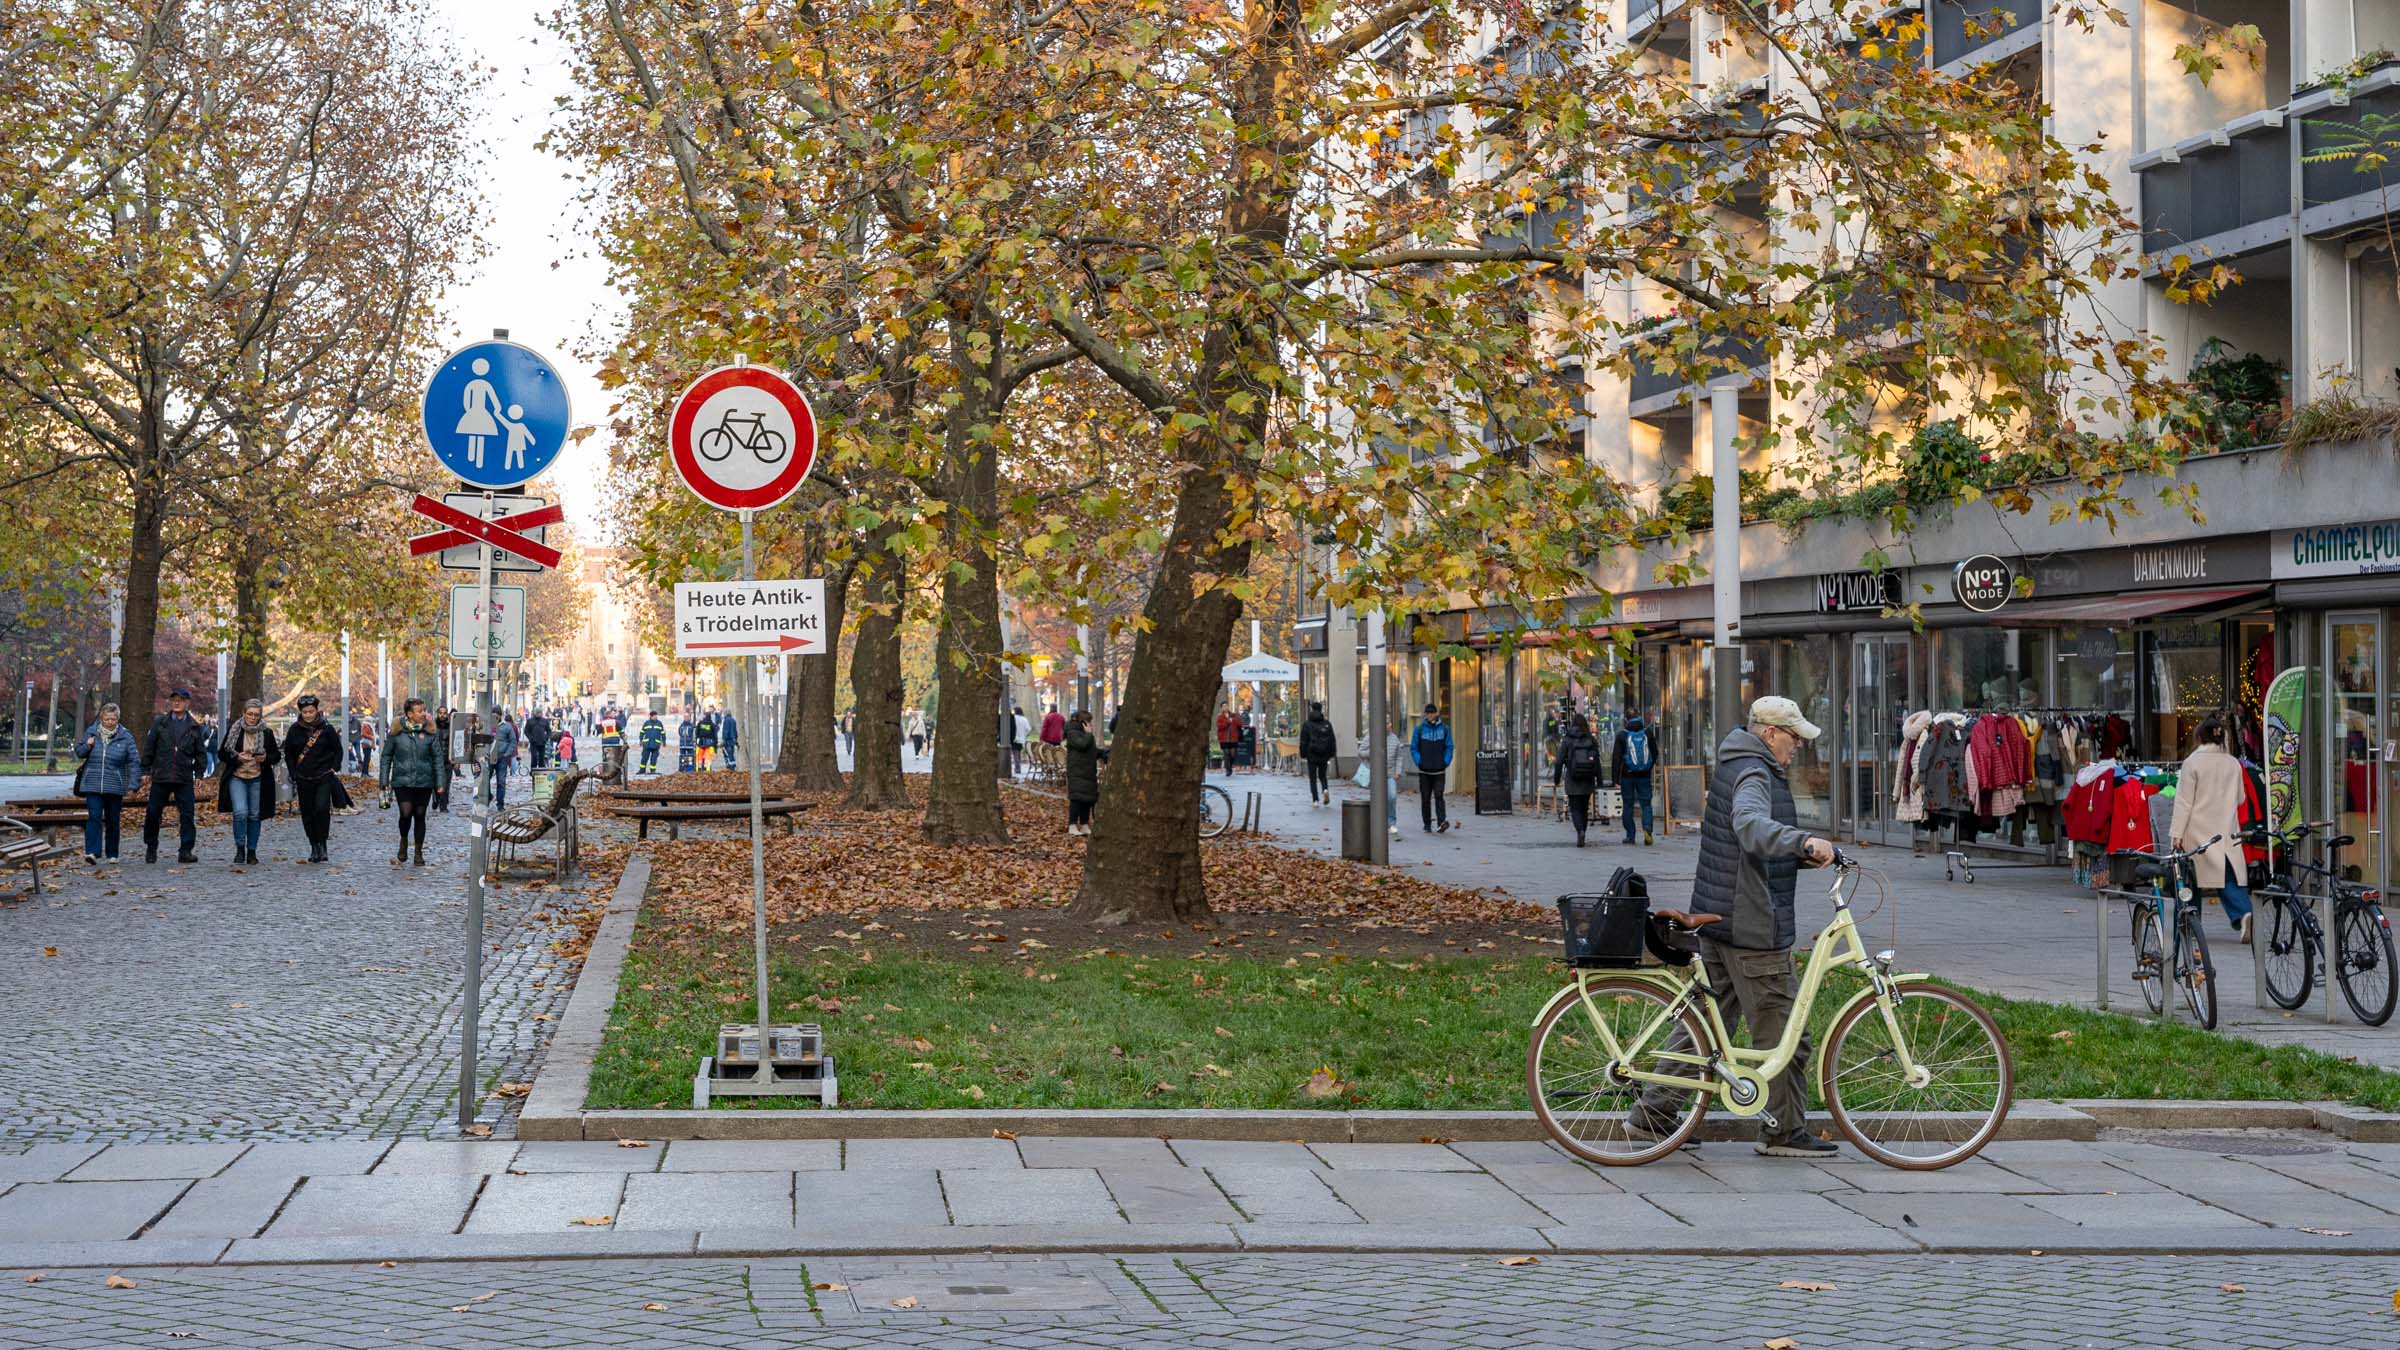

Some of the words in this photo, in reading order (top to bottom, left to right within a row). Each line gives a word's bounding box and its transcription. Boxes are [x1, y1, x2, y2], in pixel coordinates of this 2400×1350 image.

[2133, 545, 2207, 582] DAMENMODE
[687, 590, 746, 607] Heute
[751, 588, 813, 606] Antik-
[1848, 574, 1885, 606] MODE
[1967, 588, 2004, 600] MODE
[682, 622, 692, 633] &
[696, 613, 818, 633] Trödelmarkt
